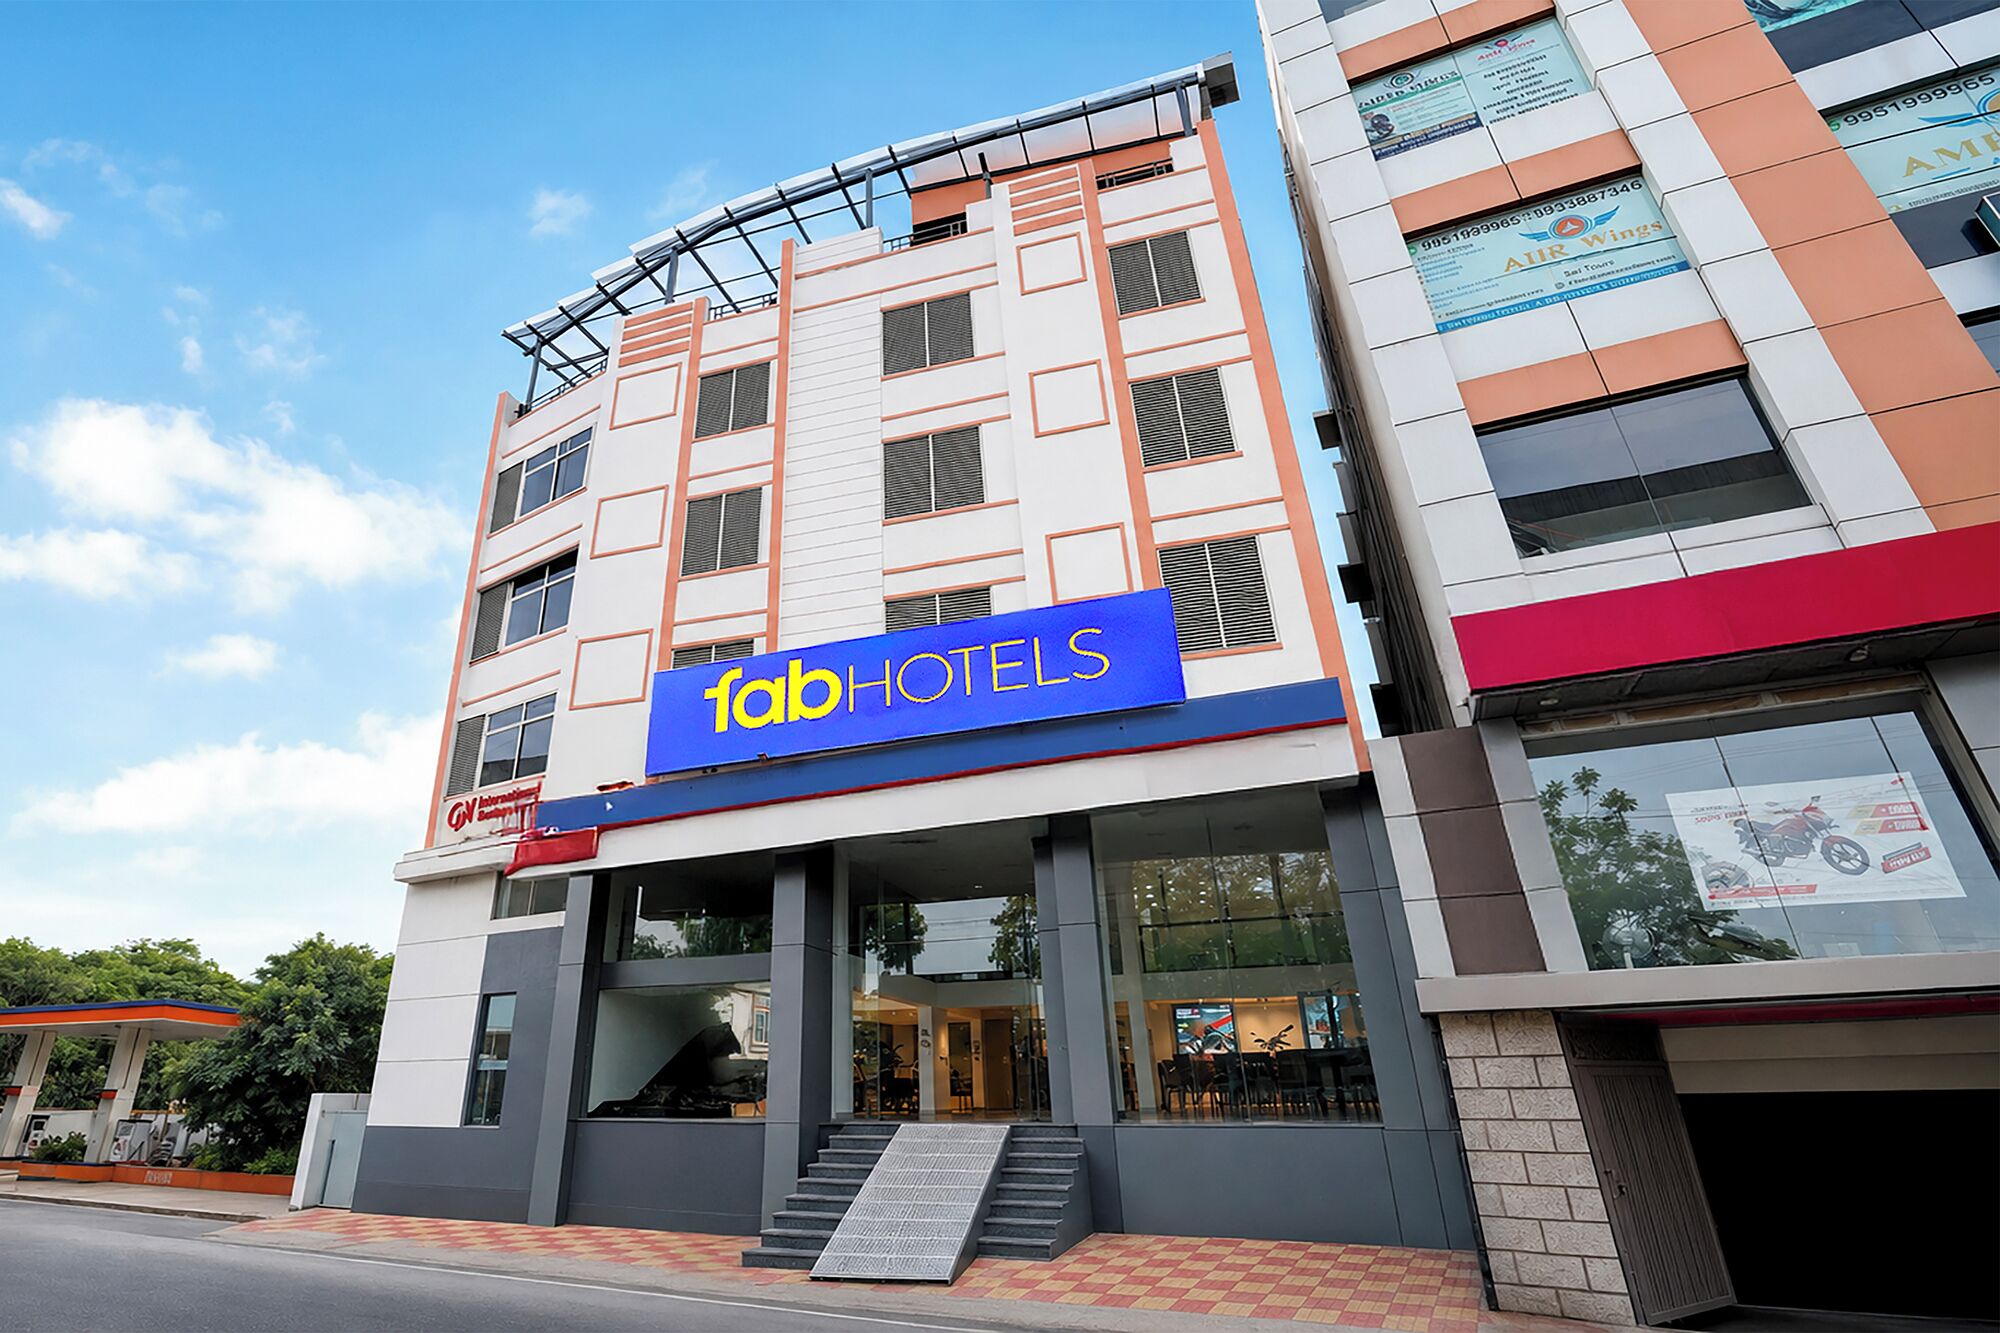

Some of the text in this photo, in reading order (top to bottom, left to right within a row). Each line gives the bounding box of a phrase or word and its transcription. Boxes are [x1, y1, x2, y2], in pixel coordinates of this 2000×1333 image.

[1843, 73, 1996, 126] 9951999965
[1580, 220, 1664, 248] Wings
[703, 627, 1112, 734] fabHOTELS
